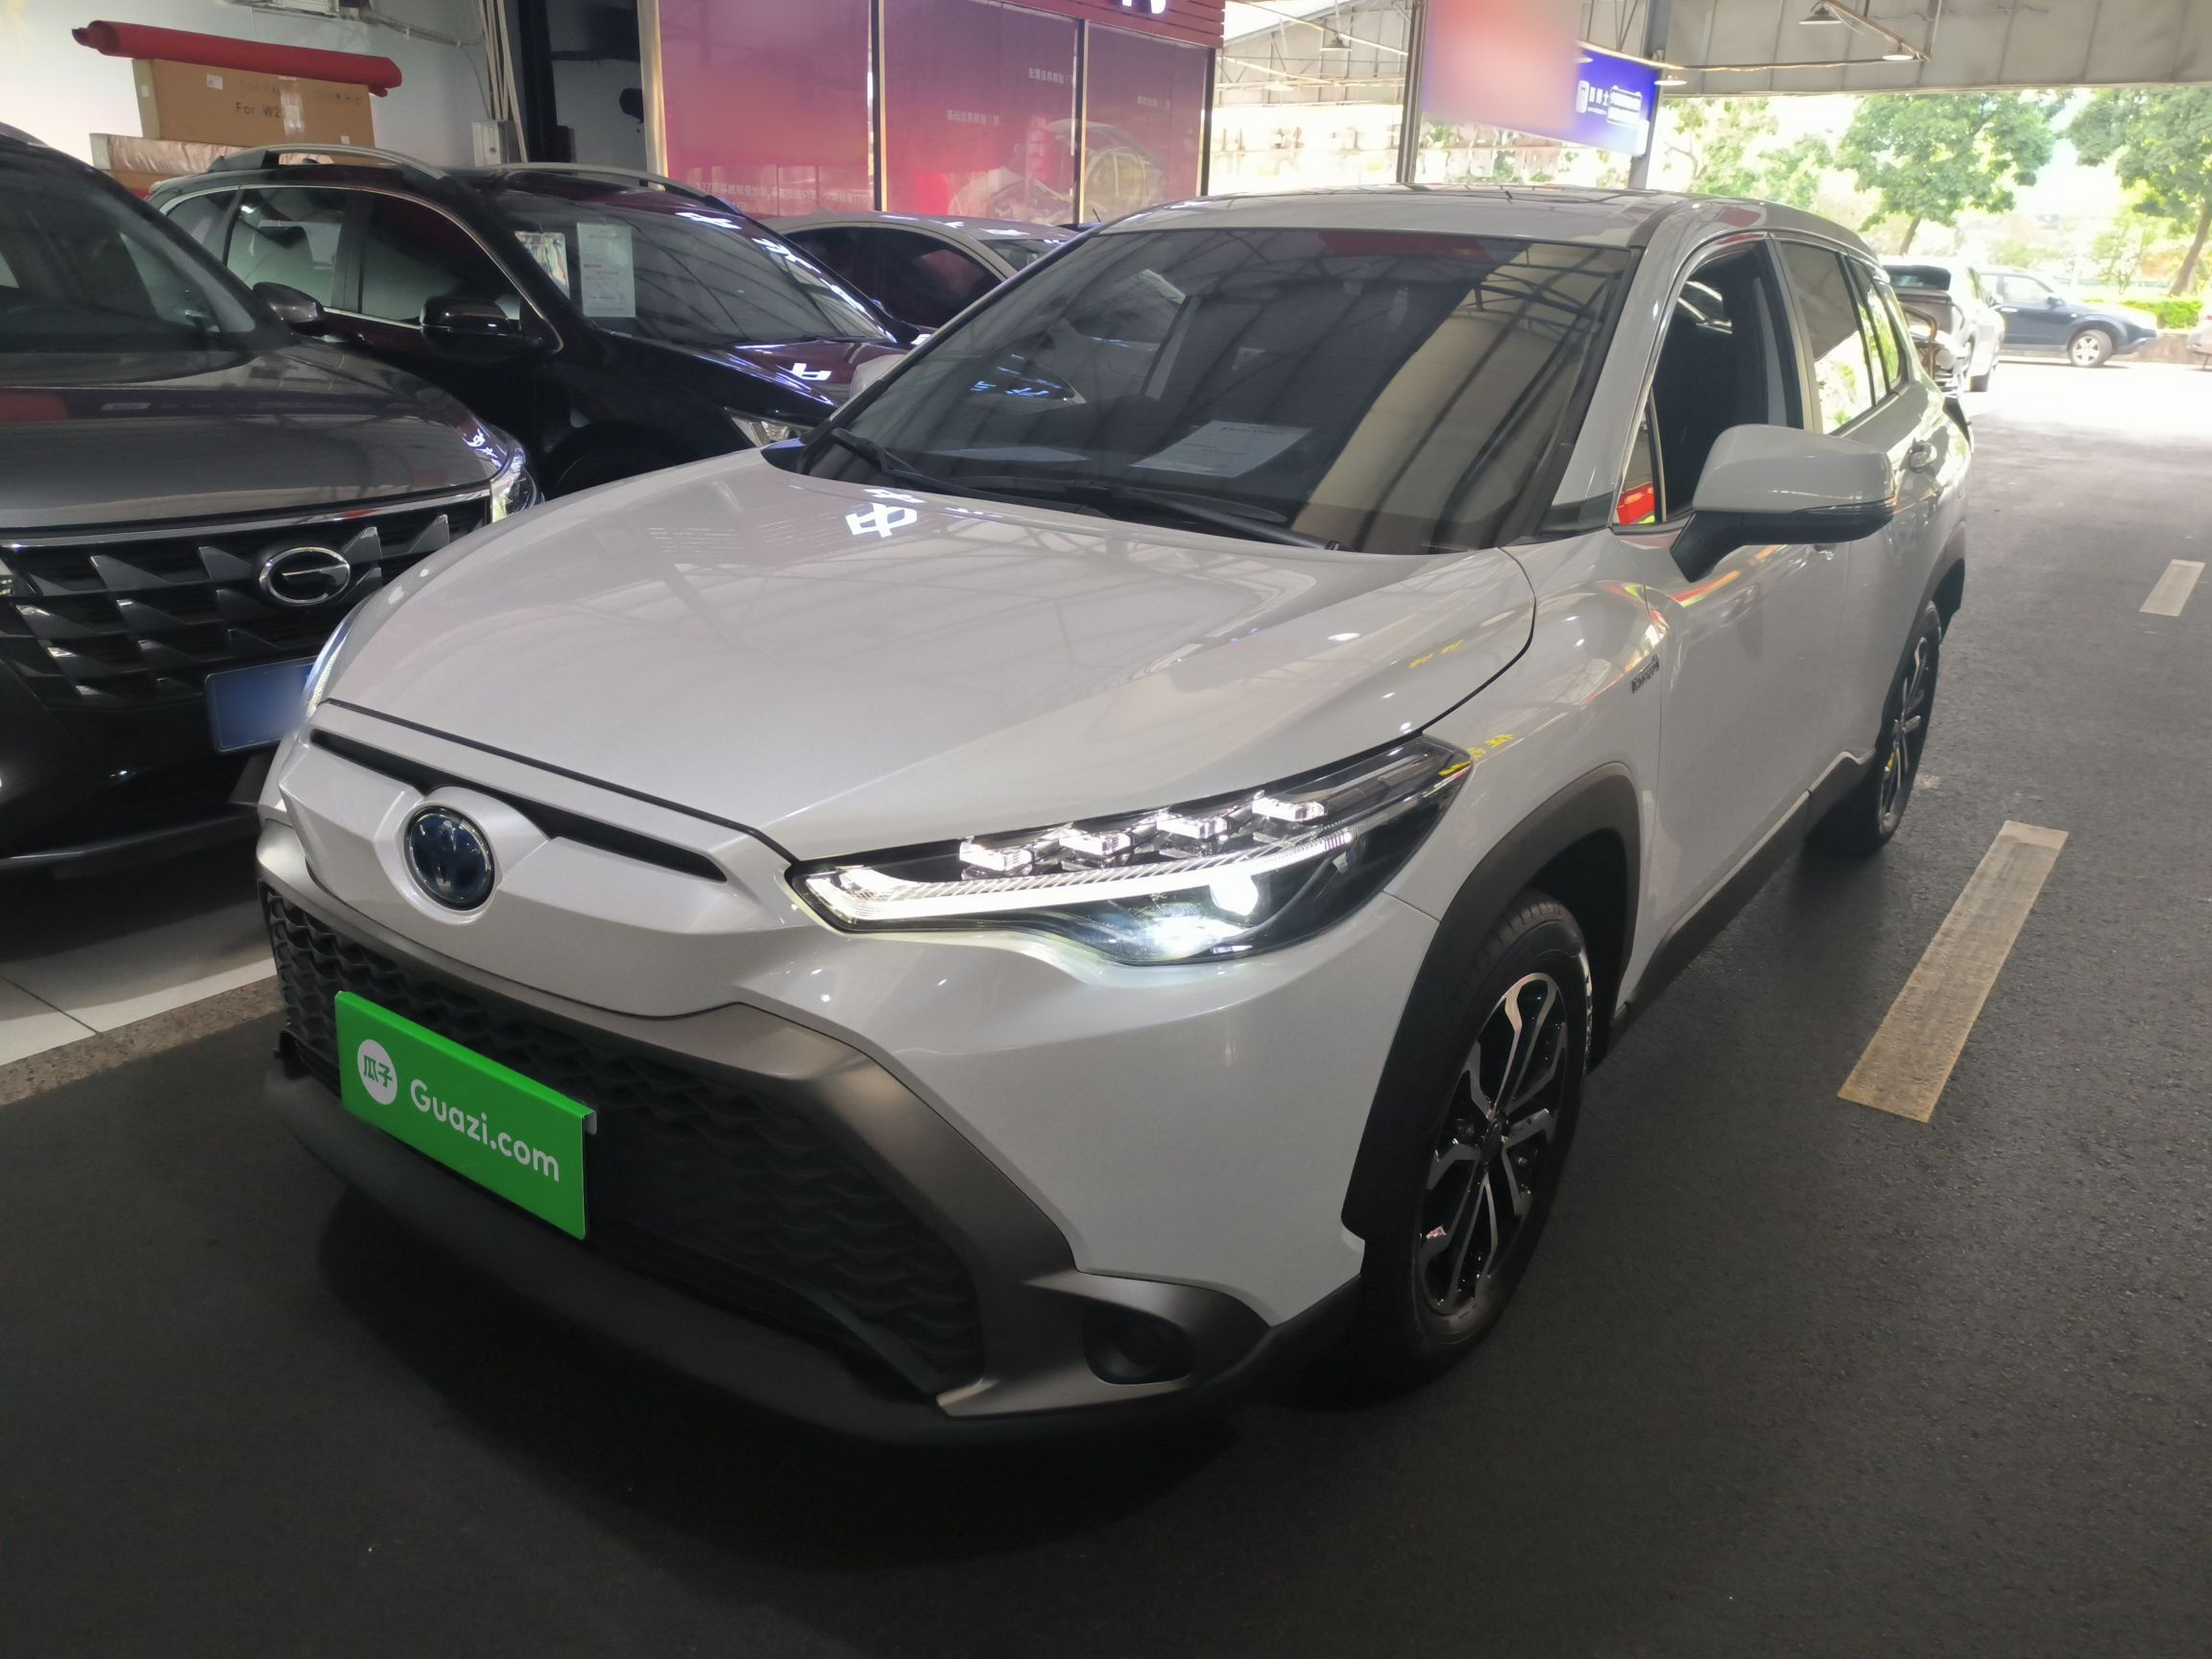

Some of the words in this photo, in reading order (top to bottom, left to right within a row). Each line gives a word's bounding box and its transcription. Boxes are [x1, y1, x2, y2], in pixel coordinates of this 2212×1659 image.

[235, 101, 254, 115] For
[363, 1055, 393, 1088] 瓜子
[410, 1078, 559, 1183] Guazi.com
